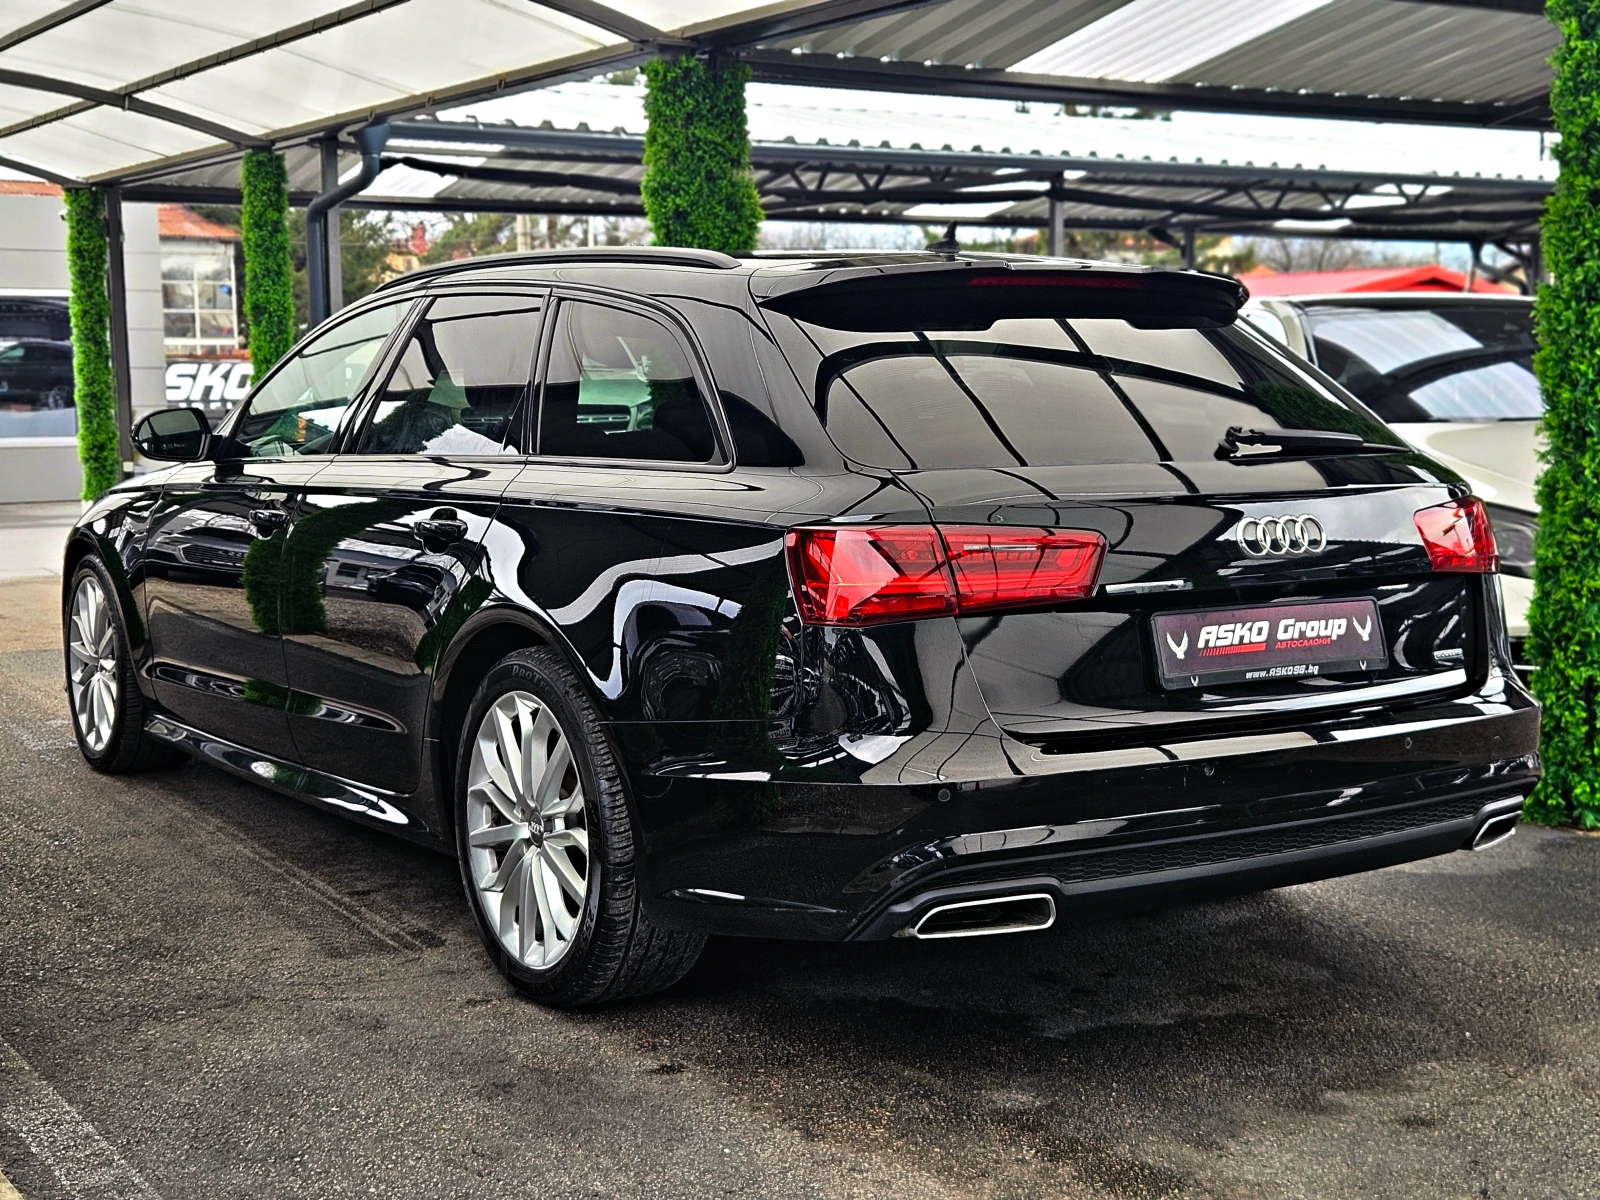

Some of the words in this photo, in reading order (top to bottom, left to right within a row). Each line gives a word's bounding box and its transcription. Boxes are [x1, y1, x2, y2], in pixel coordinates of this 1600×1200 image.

[1197, 620, 1270, 649] ASKO
[1276, 617, 1348, 641] Group
[1274, 637, 1331, 650] АВТОСАЛОНИ
